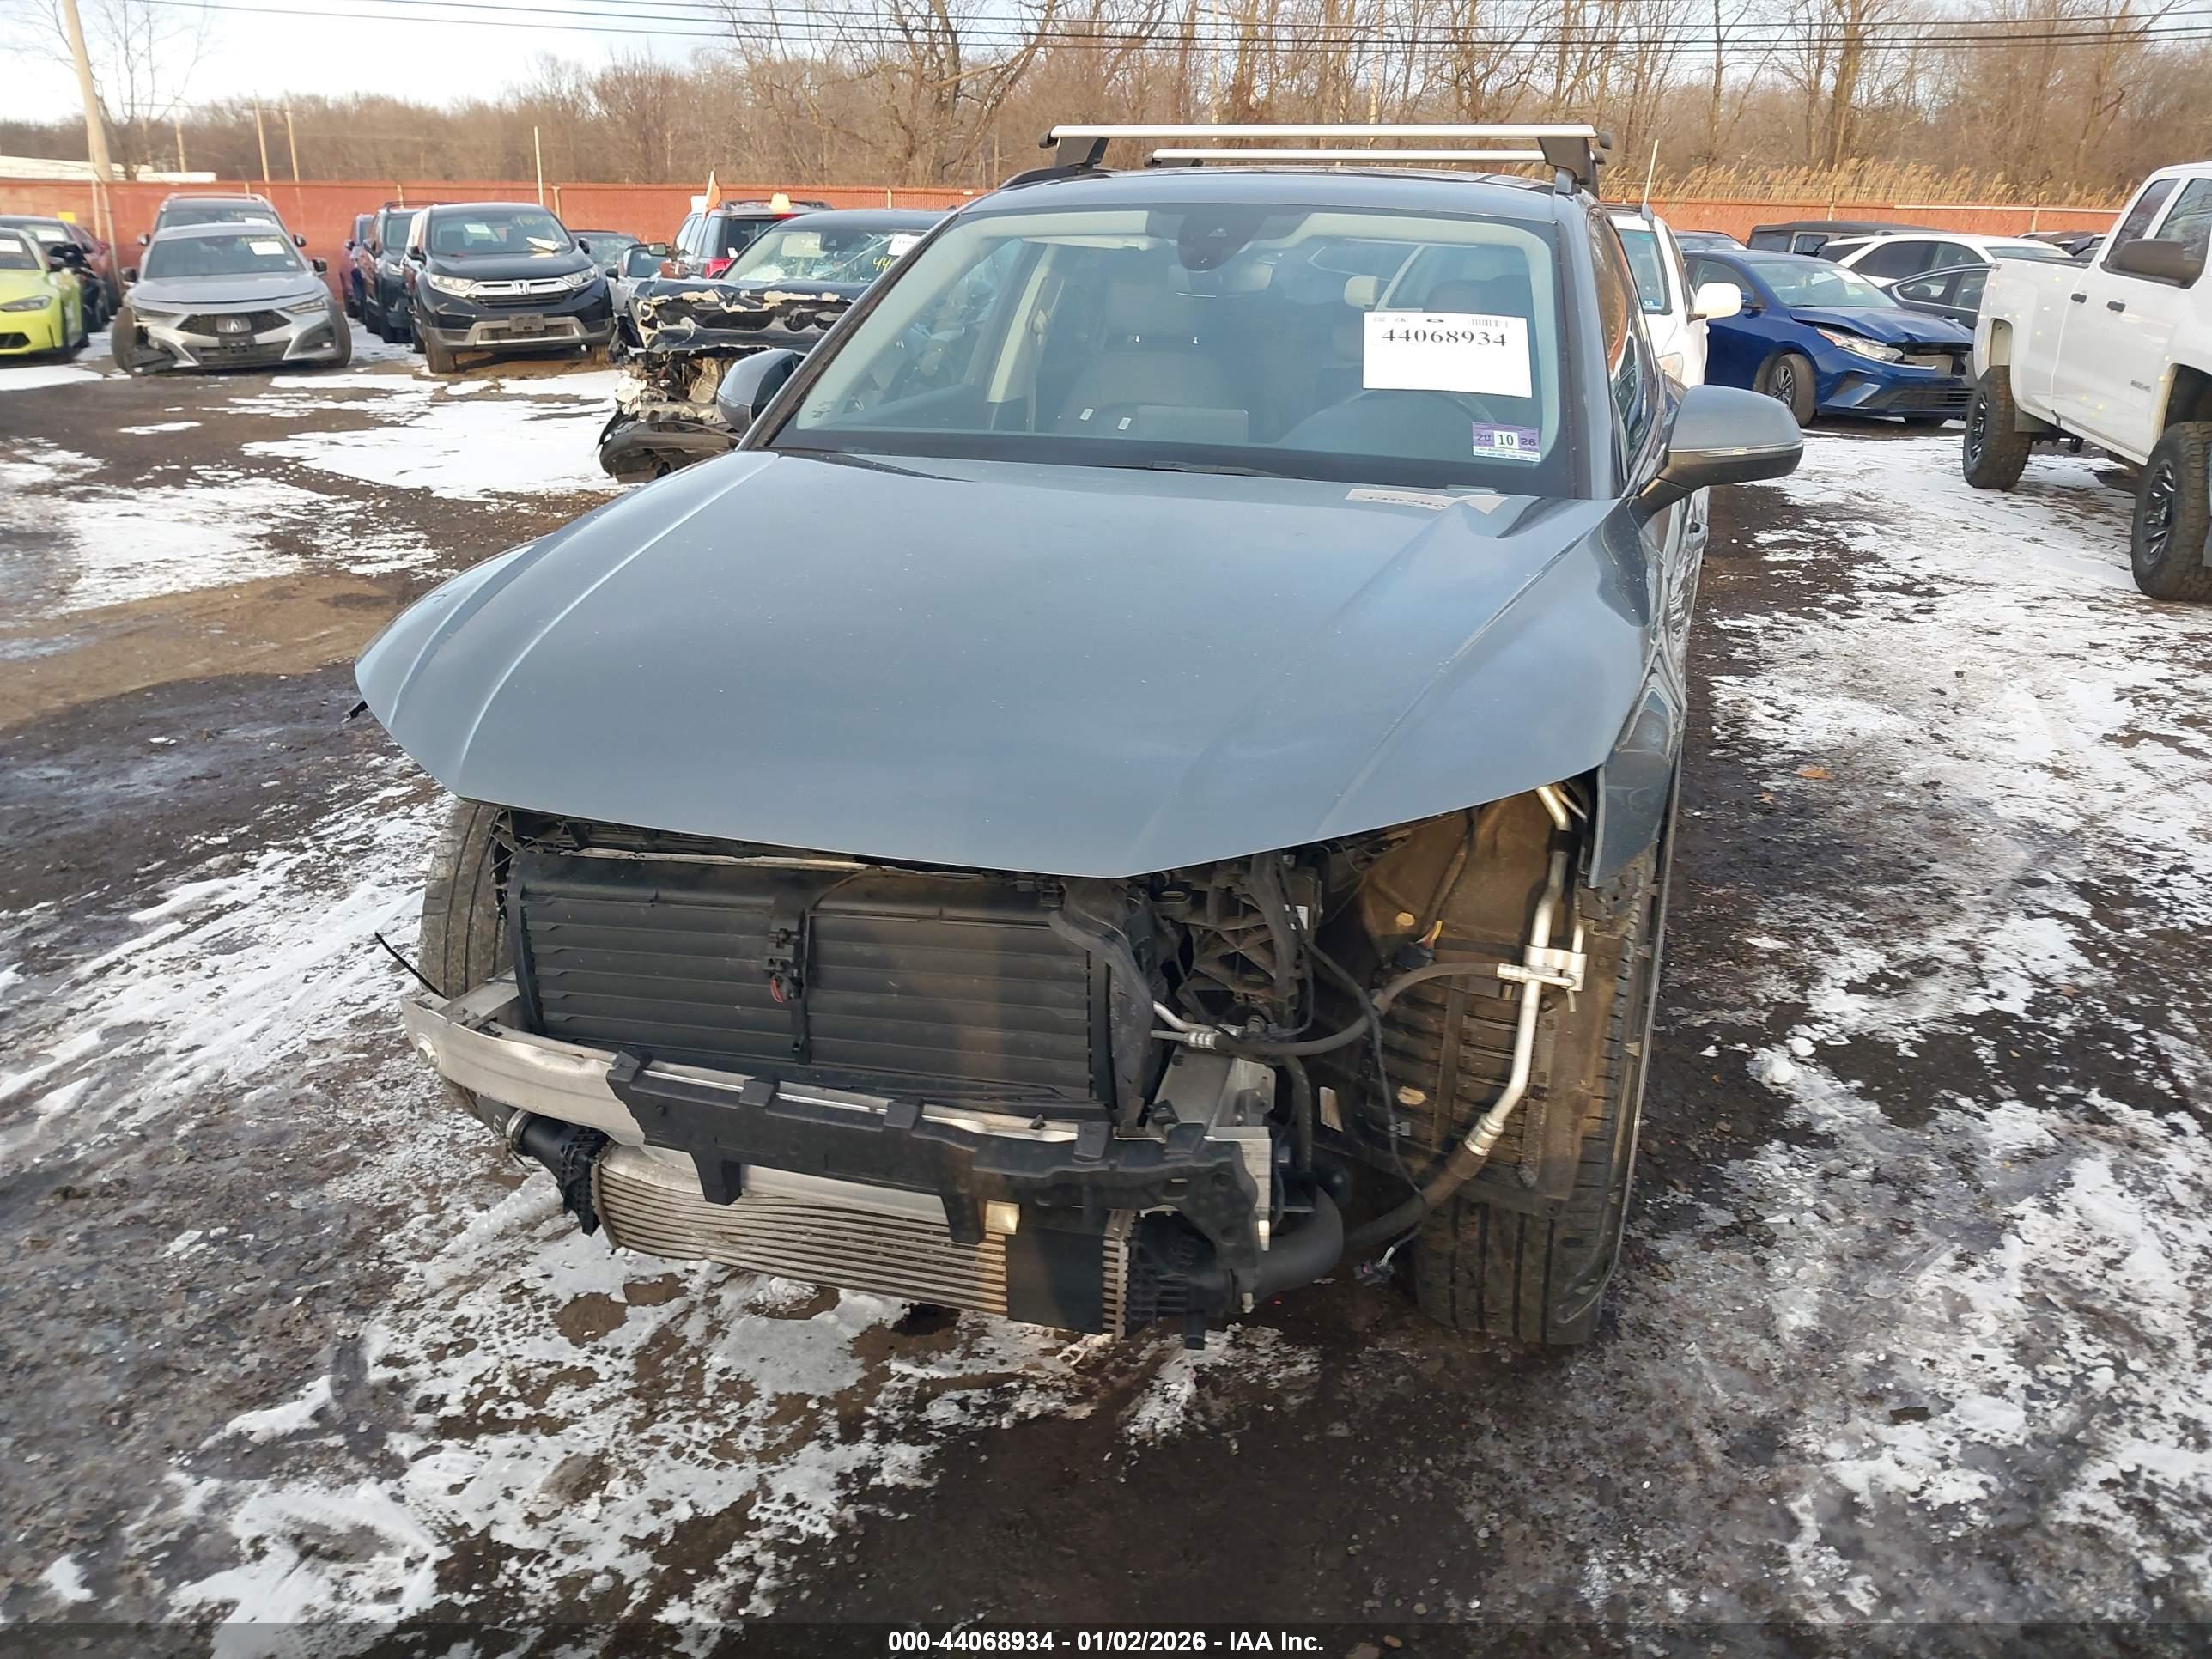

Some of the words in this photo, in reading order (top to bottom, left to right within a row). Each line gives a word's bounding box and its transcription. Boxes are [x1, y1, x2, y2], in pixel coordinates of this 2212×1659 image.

[1382, 329, 1507, 346] 44068934
[1498, 433, 1514, 446] 10
[1520, 437, 1536, 446] 26
